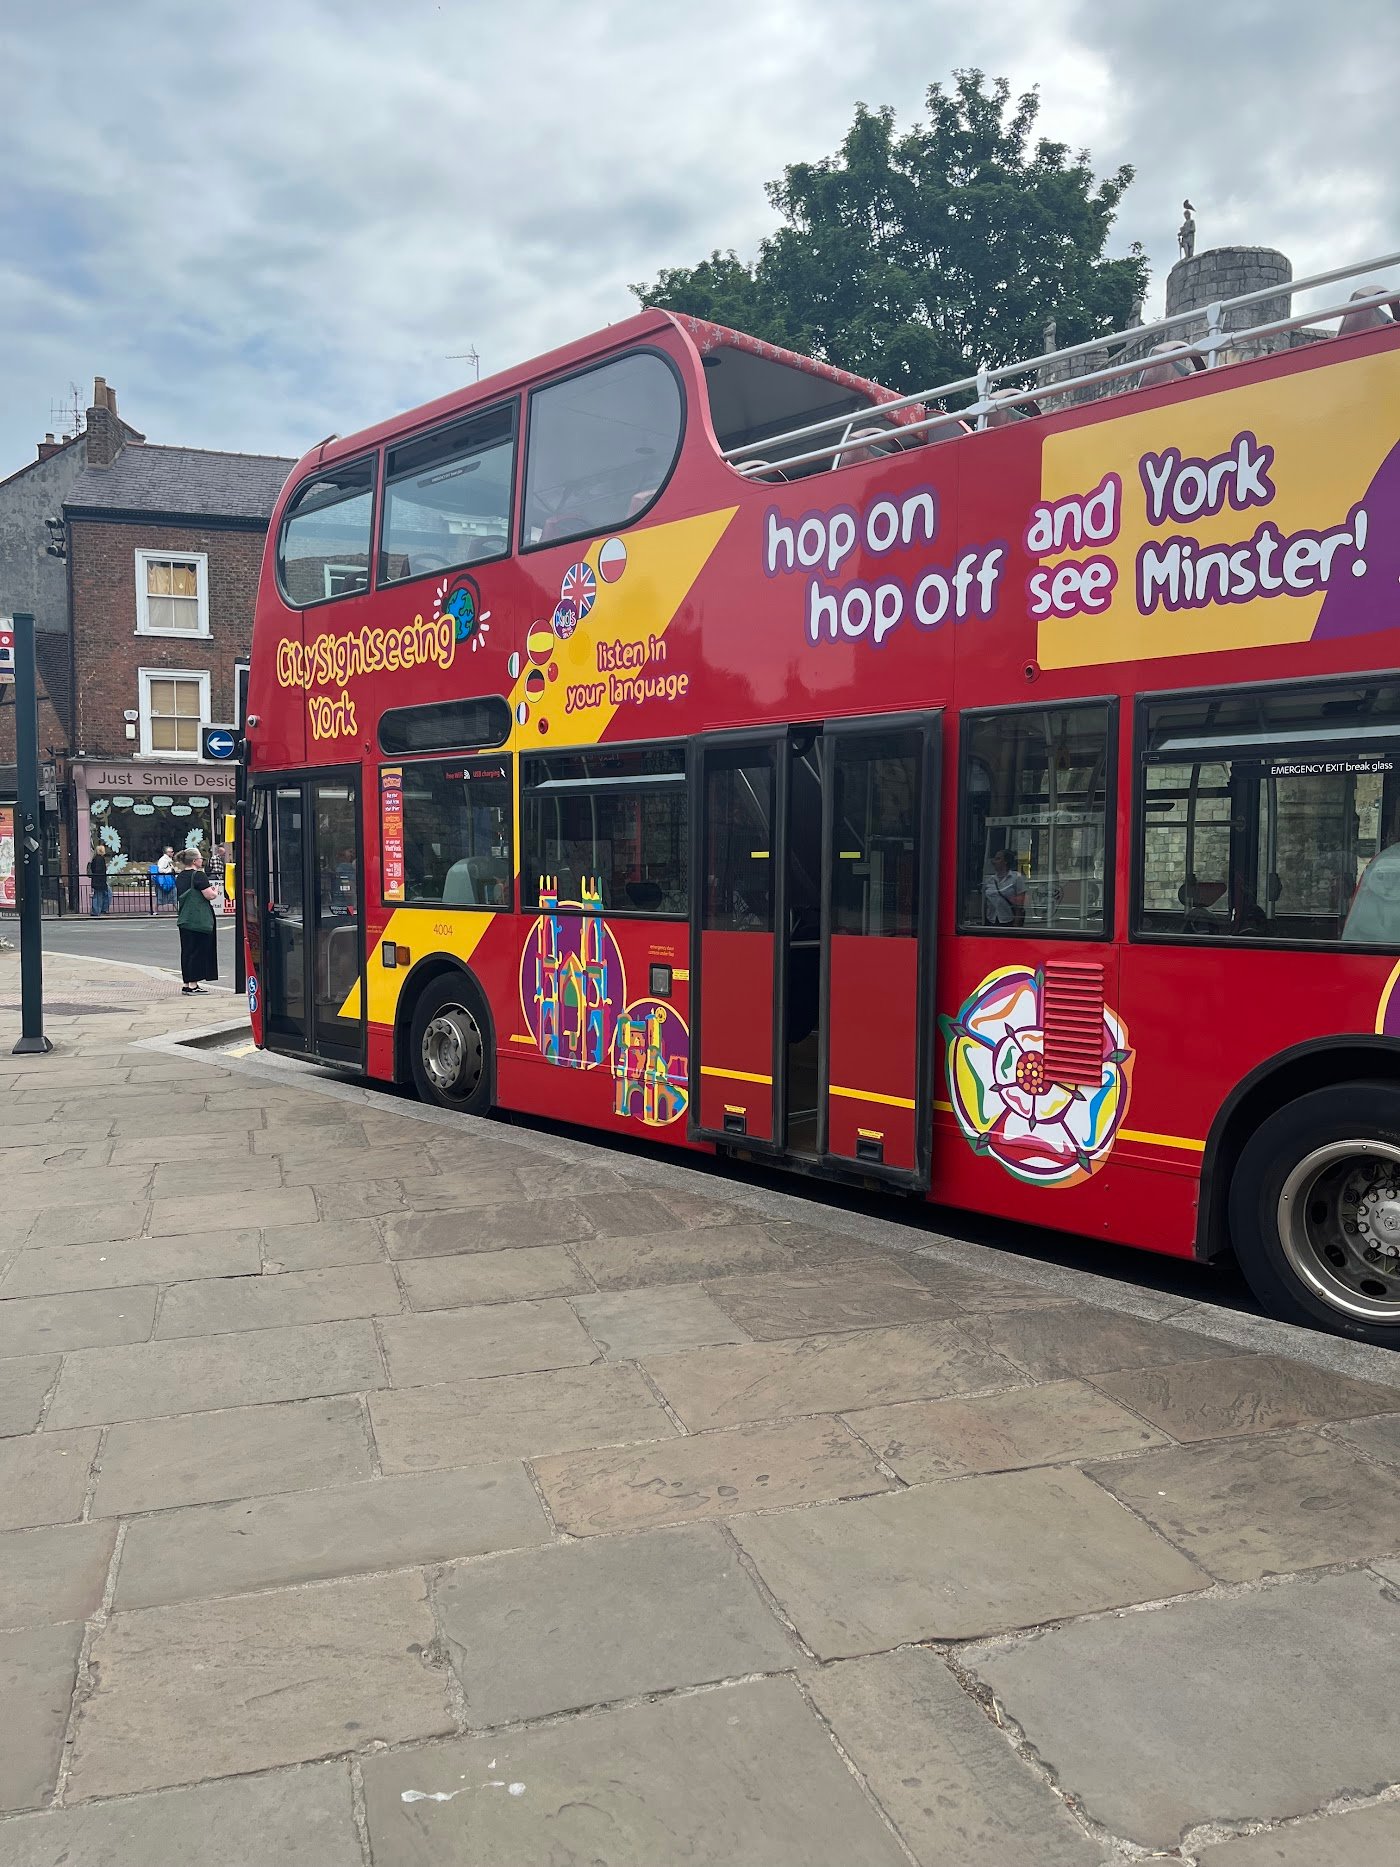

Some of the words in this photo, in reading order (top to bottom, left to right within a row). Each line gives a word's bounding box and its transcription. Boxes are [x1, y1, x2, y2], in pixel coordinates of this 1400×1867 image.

[1145, 438, 1268, 519] York
[767, 512, 857, 572] hop
[866, 492, 935, 552] on
[1026, 479, 1115, 552] and
[1141, 508, 1368, 608] Minster!
[809, 579, 904, 644] hop
[914, 548, 1003, 626] off
[1028, 561, 1112, 614] see
[598, 641, 645, 671] listen
[649, 636, 667, 662] in
[308, 690, 358, 740] York
[566, 684, 606, 713] your
[609, 673, 690, 705] language
[98, 771, 133, 785] Just
[142, 772, 189, 786] Smile
[1270, 763, 1325, 775] EMERGENCY
[1325, 762, 1345, 773] EXIT
[1345, 761, 1370, 772] break
[1371, 760, 1393, 773] glass
[433, 924, 454, 936] 4004
